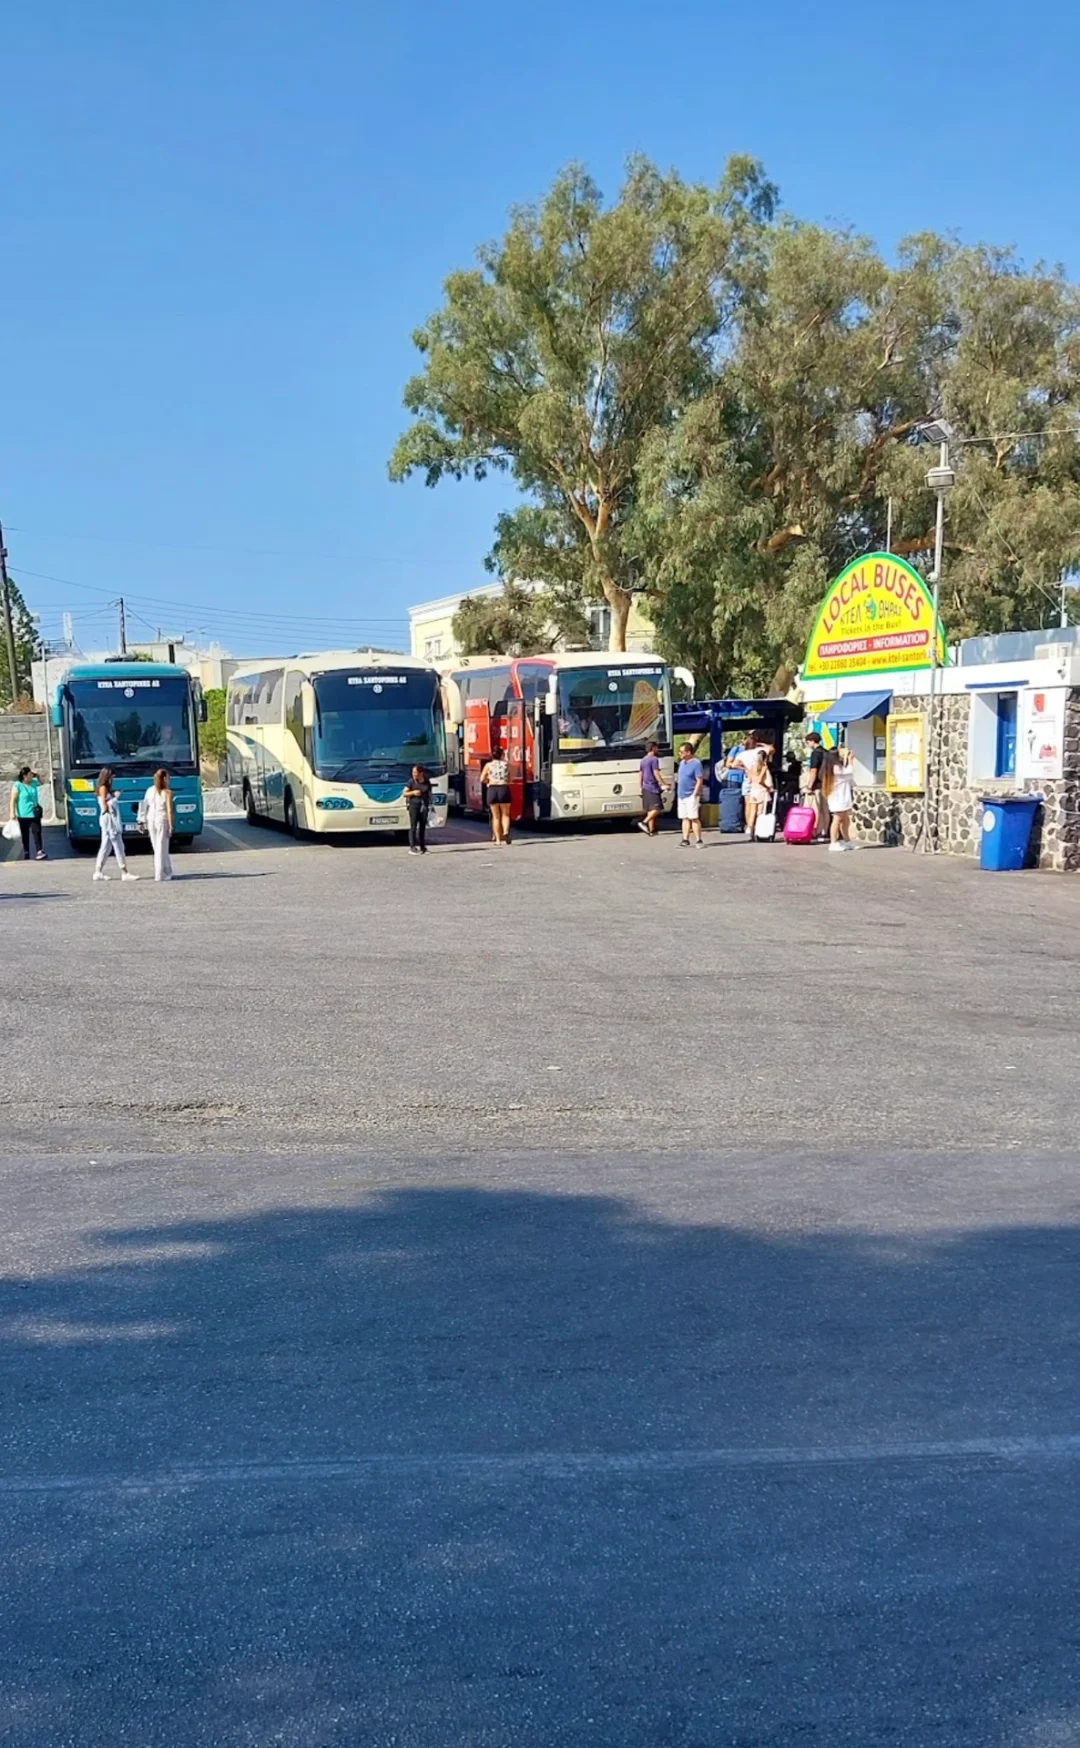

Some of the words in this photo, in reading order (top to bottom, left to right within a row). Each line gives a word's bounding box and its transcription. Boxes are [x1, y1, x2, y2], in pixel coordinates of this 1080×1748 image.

[823, 567, 868, 635] LOCAL
[873, 563, 925, 621] BUSES
[839, 604, 862, 626] ΚΤΕΛ
[841, 625, 863, 635] Tickets
[864, 623, 871, 633] in
[872, 622, 885, 632] the
[819, 639, 868, 656] ΠΛΗΡΟΦΟΡΙΕΣ
[873, 632, 927, 649] INFORMATION
[818, 660, 830, 671] +30
